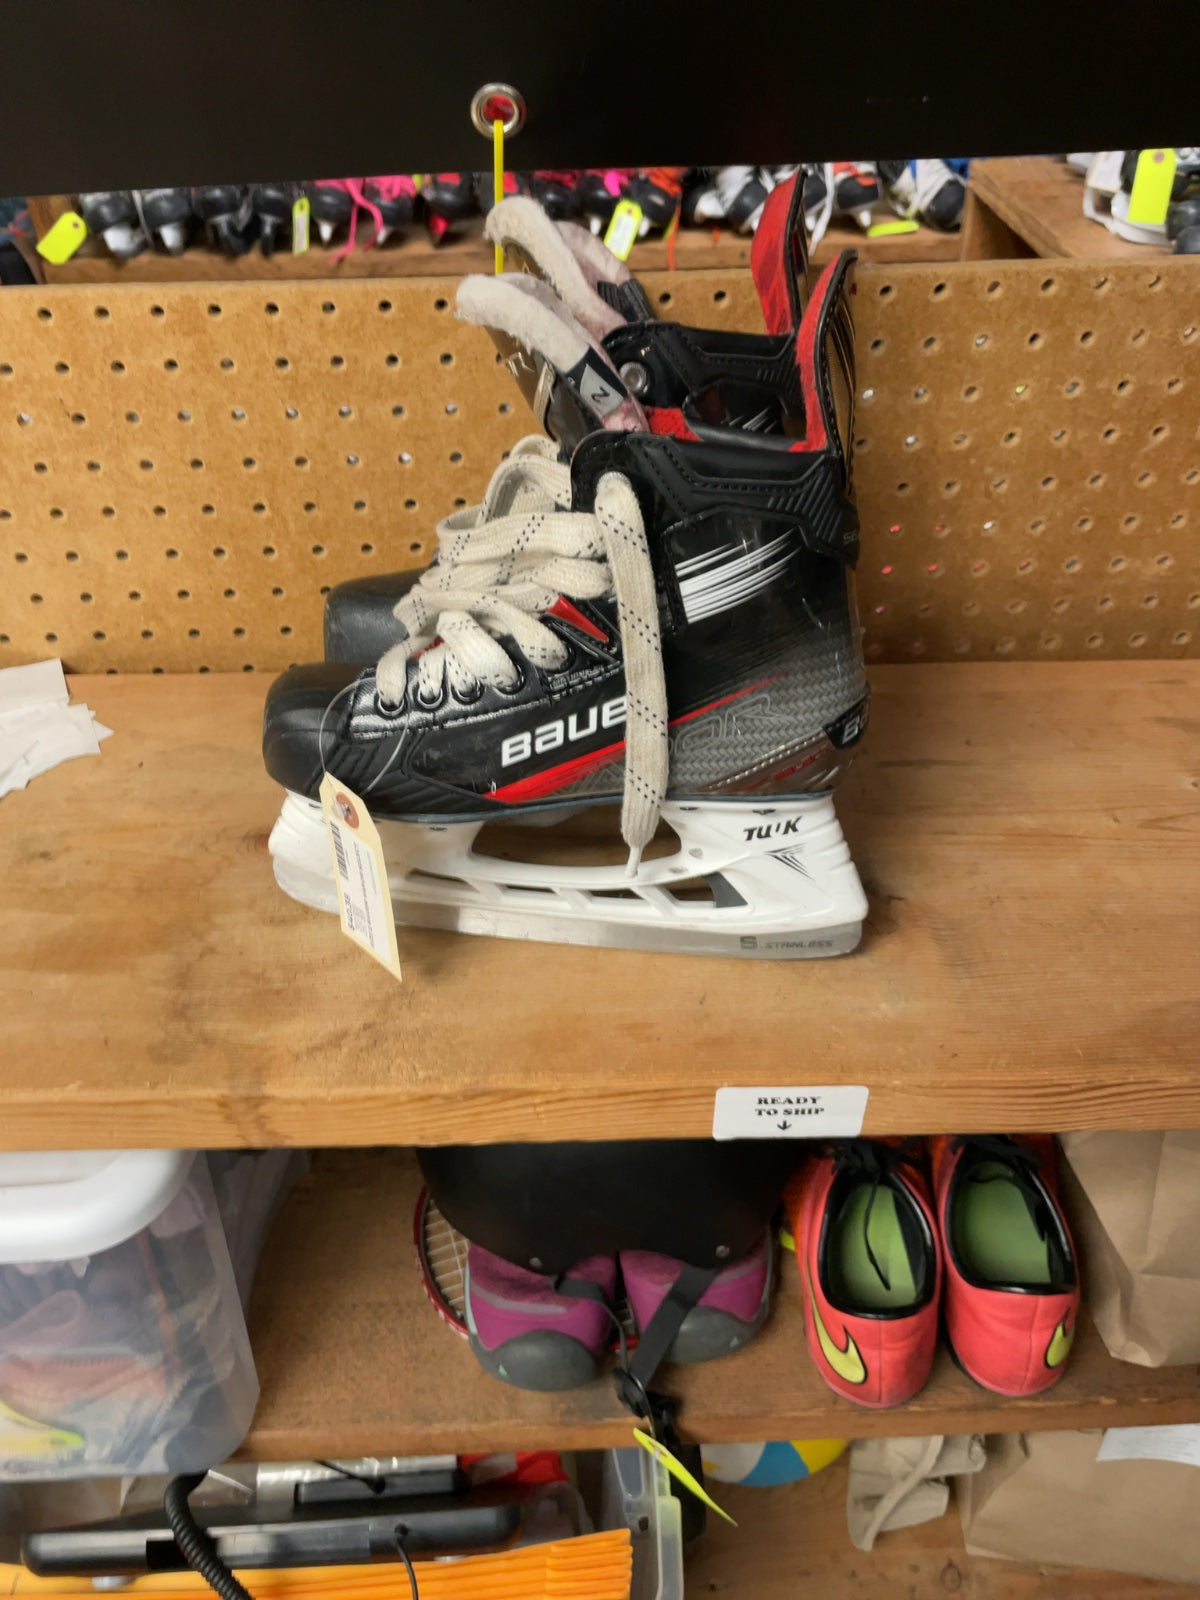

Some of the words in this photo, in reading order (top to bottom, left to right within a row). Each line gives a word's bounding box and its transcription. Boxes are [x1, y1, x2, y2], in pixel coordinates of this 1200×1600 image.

[501, 695, 627, 768] BAUE
[757, 1096, 822, 1105] READY
[755, 1108, 778, 1116] TO
[783, 1107, 825, 1116] SHIP
